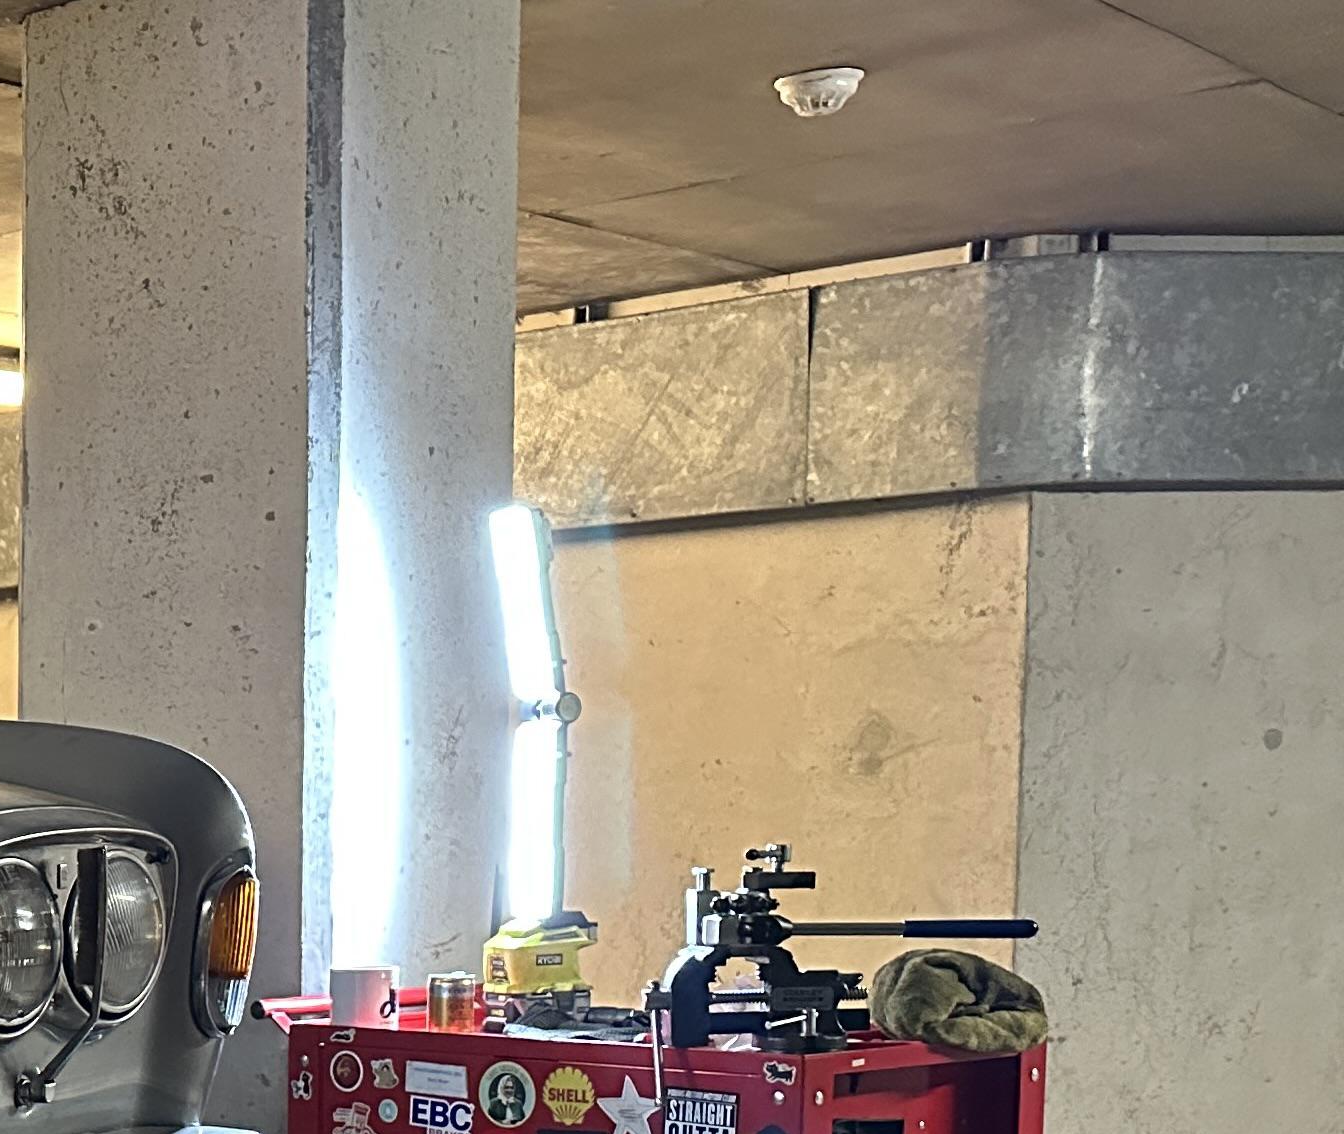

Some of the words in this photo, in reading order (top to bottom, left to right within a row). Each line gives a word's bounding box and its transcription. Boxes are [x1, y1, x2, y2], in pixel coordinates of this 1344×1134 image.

[548, 1087, 589, 1103] SHELL
[412, 1098, 472, 1132] EBC
[668, 1099, 733, 1127] STRAIGHT
